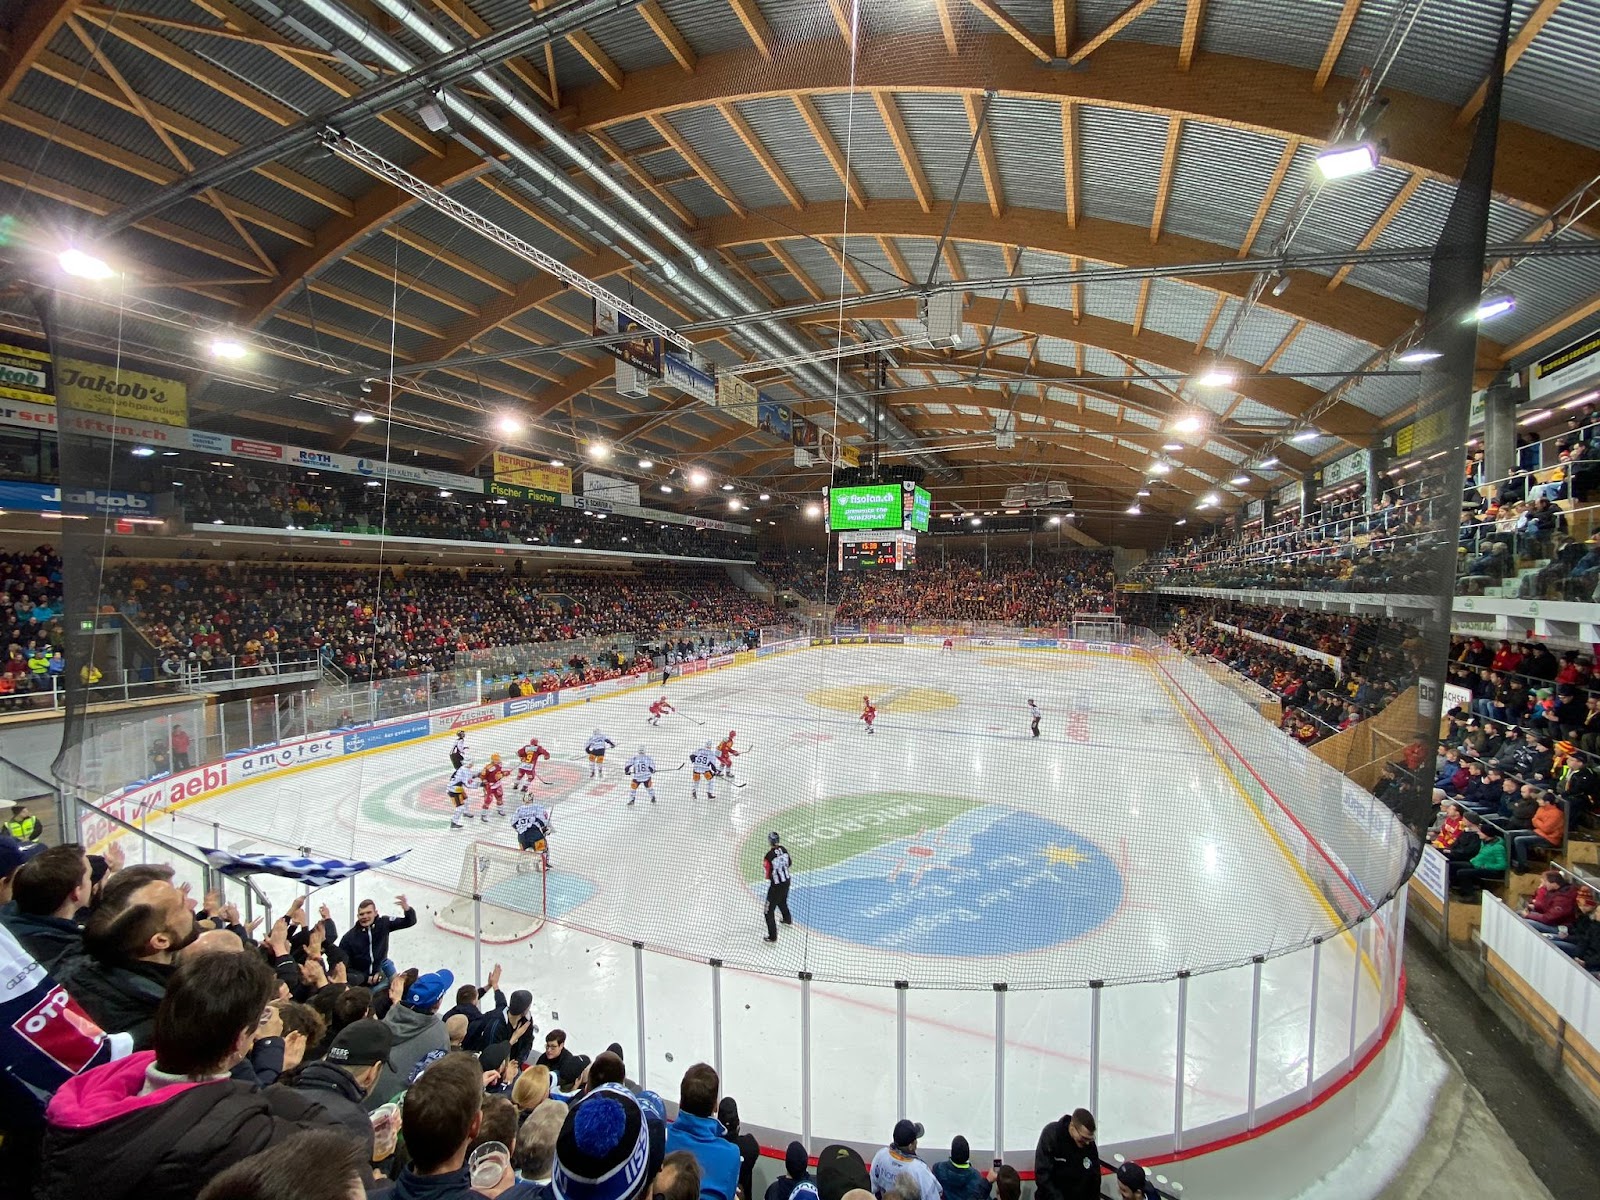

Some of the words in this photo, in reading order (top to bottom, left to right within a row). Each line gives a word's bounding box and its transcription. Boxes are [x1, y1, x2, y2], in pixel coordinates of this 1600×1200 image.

[60, 368, 168, 403] Jakob's
[300, 451, 330, 462] ROTH
[498, 455, 531, 468] RETIRED
[41, 488, 147, 508] Jakob
[491, 483, 522, 498] Fischer
[528, 489, 556, 503] Fischer
[242, 740, 333, 770] amotec
[170, 764, 228, 803] aebi
